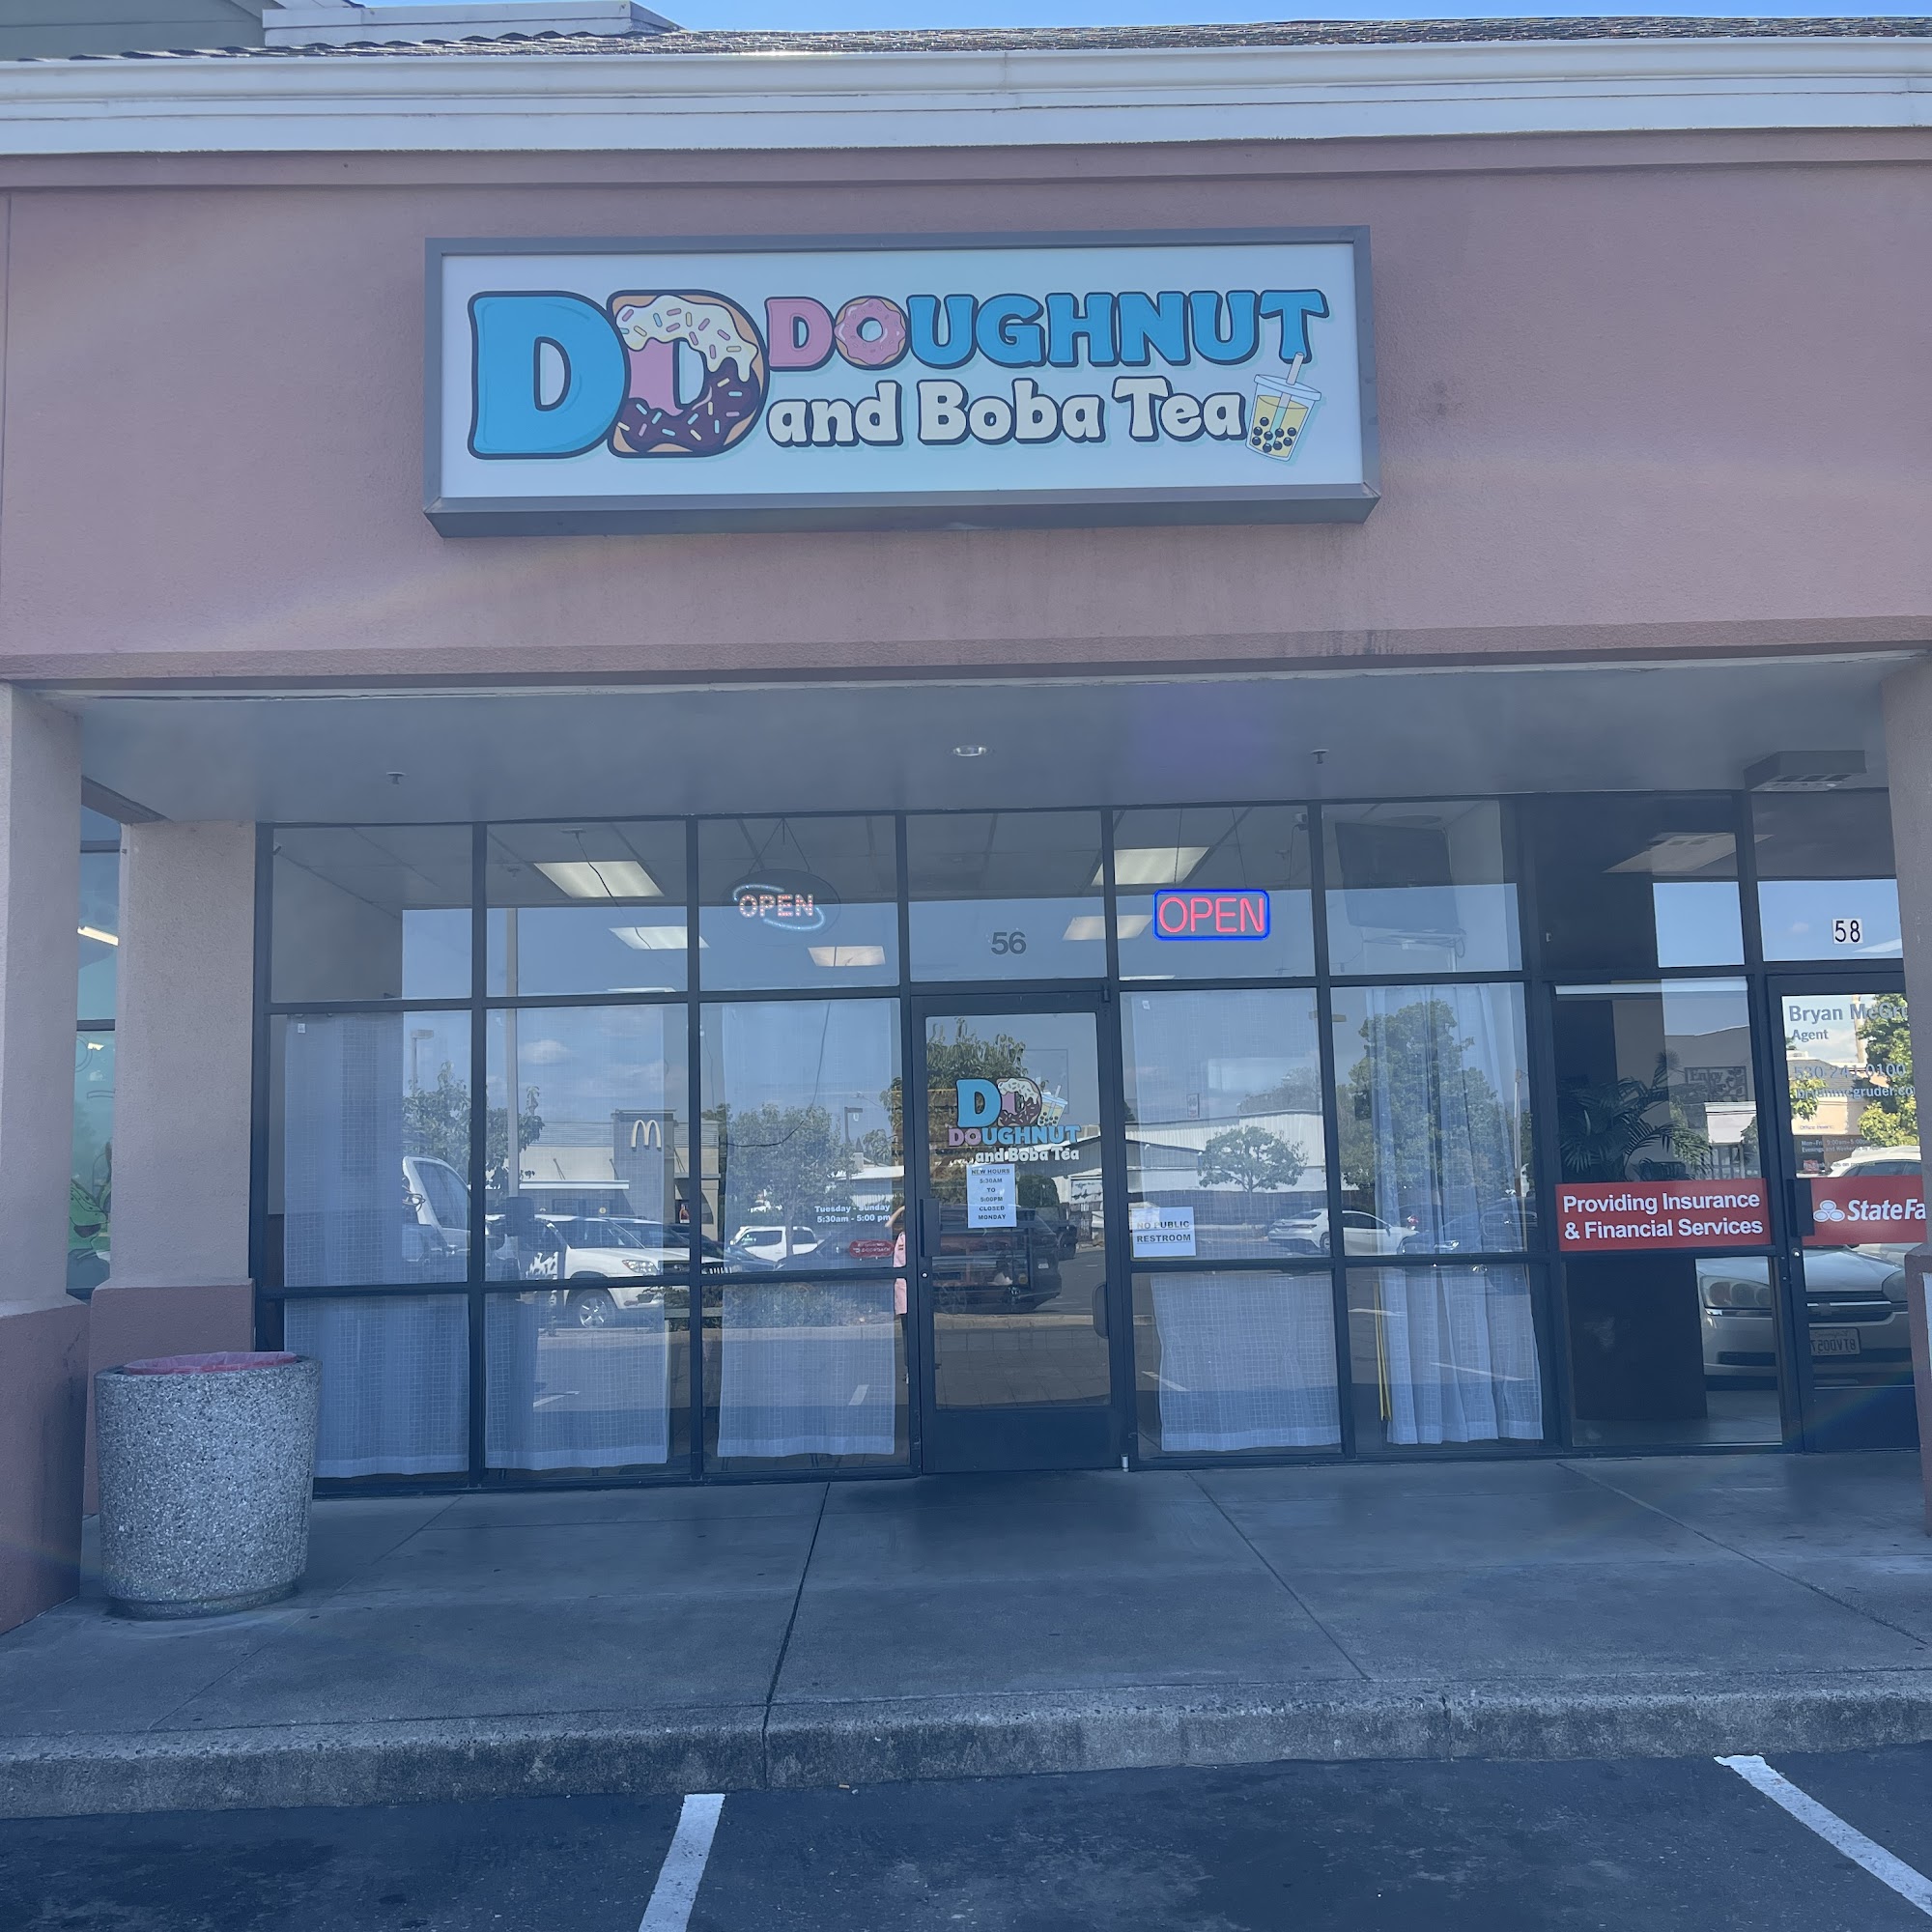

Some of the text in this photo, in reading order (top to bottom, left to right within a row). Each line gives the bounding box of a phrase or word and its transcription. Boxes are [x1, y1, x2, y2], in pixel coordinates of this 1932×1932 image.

[764, 288, 1329, 373] DOUGHNUT
[766, 375, 1249, 447] and Boba Tea
[738, 894, 814, 918] OPEN
[1158, 896, 1264, 933] OPEN
[1834, 920, 1861, 943] 58
[990, 931, 1027, 955] 56
[1788, 1005, 1843, 1024] Bryan
[1791, 1029, 1830, 1042] Agent
[1796, 1086, 1916, 1100] bryanmcgruder.co
[948, 1124, 1082, 1147] DOUGHNUT
[975, 1146, 1080, 1164] and Boba Tea
[814, 1205, 851, 1213] Tuesday
[858, 1204, 891, 1212] Sunday
[1563, 1192, 1761, 1215] Providing Insurance
[877, 1214, 892, 1223] pm
[1153, 1220, 1190, 1229] PUBLIC
[1564, 1218, 1764, 1240] & Financial Services
[1136, 1234, 1191, 1243] RESTROOM
